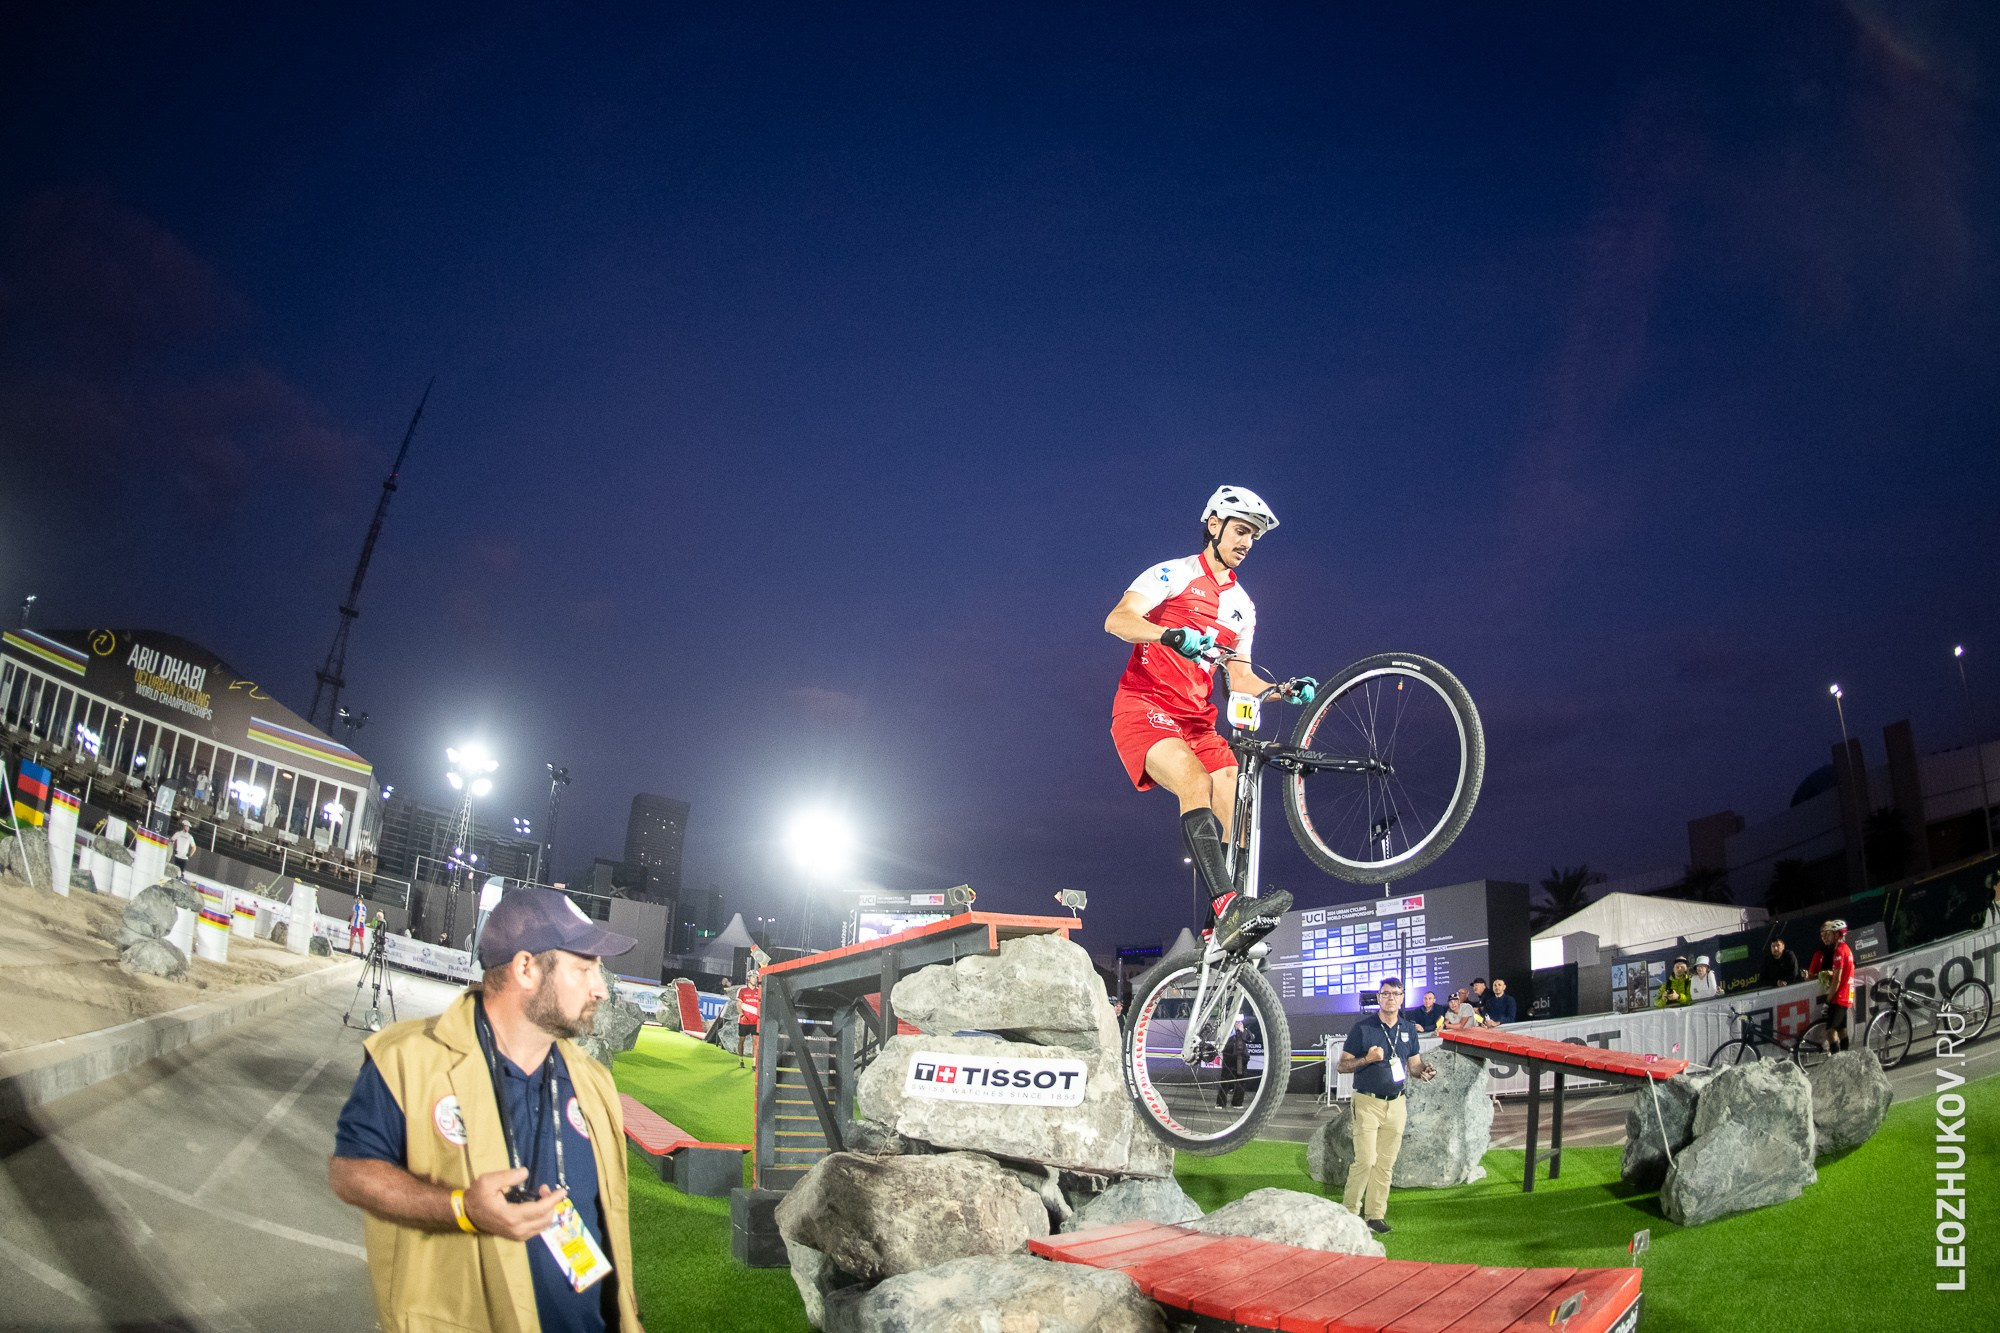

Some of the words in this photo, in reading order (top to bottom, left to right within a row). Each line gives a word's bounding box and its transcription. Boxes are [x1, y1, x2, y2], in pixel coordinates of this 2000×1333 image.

[126, 643, 160, 674] ABU
[160, 654, 207, 692] DHABI
[134, 669, 149, 684] UCI
[148, 674, 177, 696] URBAN
[176, 685, 211, 708] CYCLING
[135, 682, 159, 701] WORLD
[158, 692, 213, 721] CHAMPIONSHIPS
[1306, 913, 1325, 924] UCI
[1860, 951, 1877, 960] TRIALS
[962, 1067, 1079, 1090] TISSOT
[912, 1083, 946, 1094] SWISS
[951, 1087, 1004, 1098] WATCHES
[1010, 1091, 1042, 1099] SINCE
